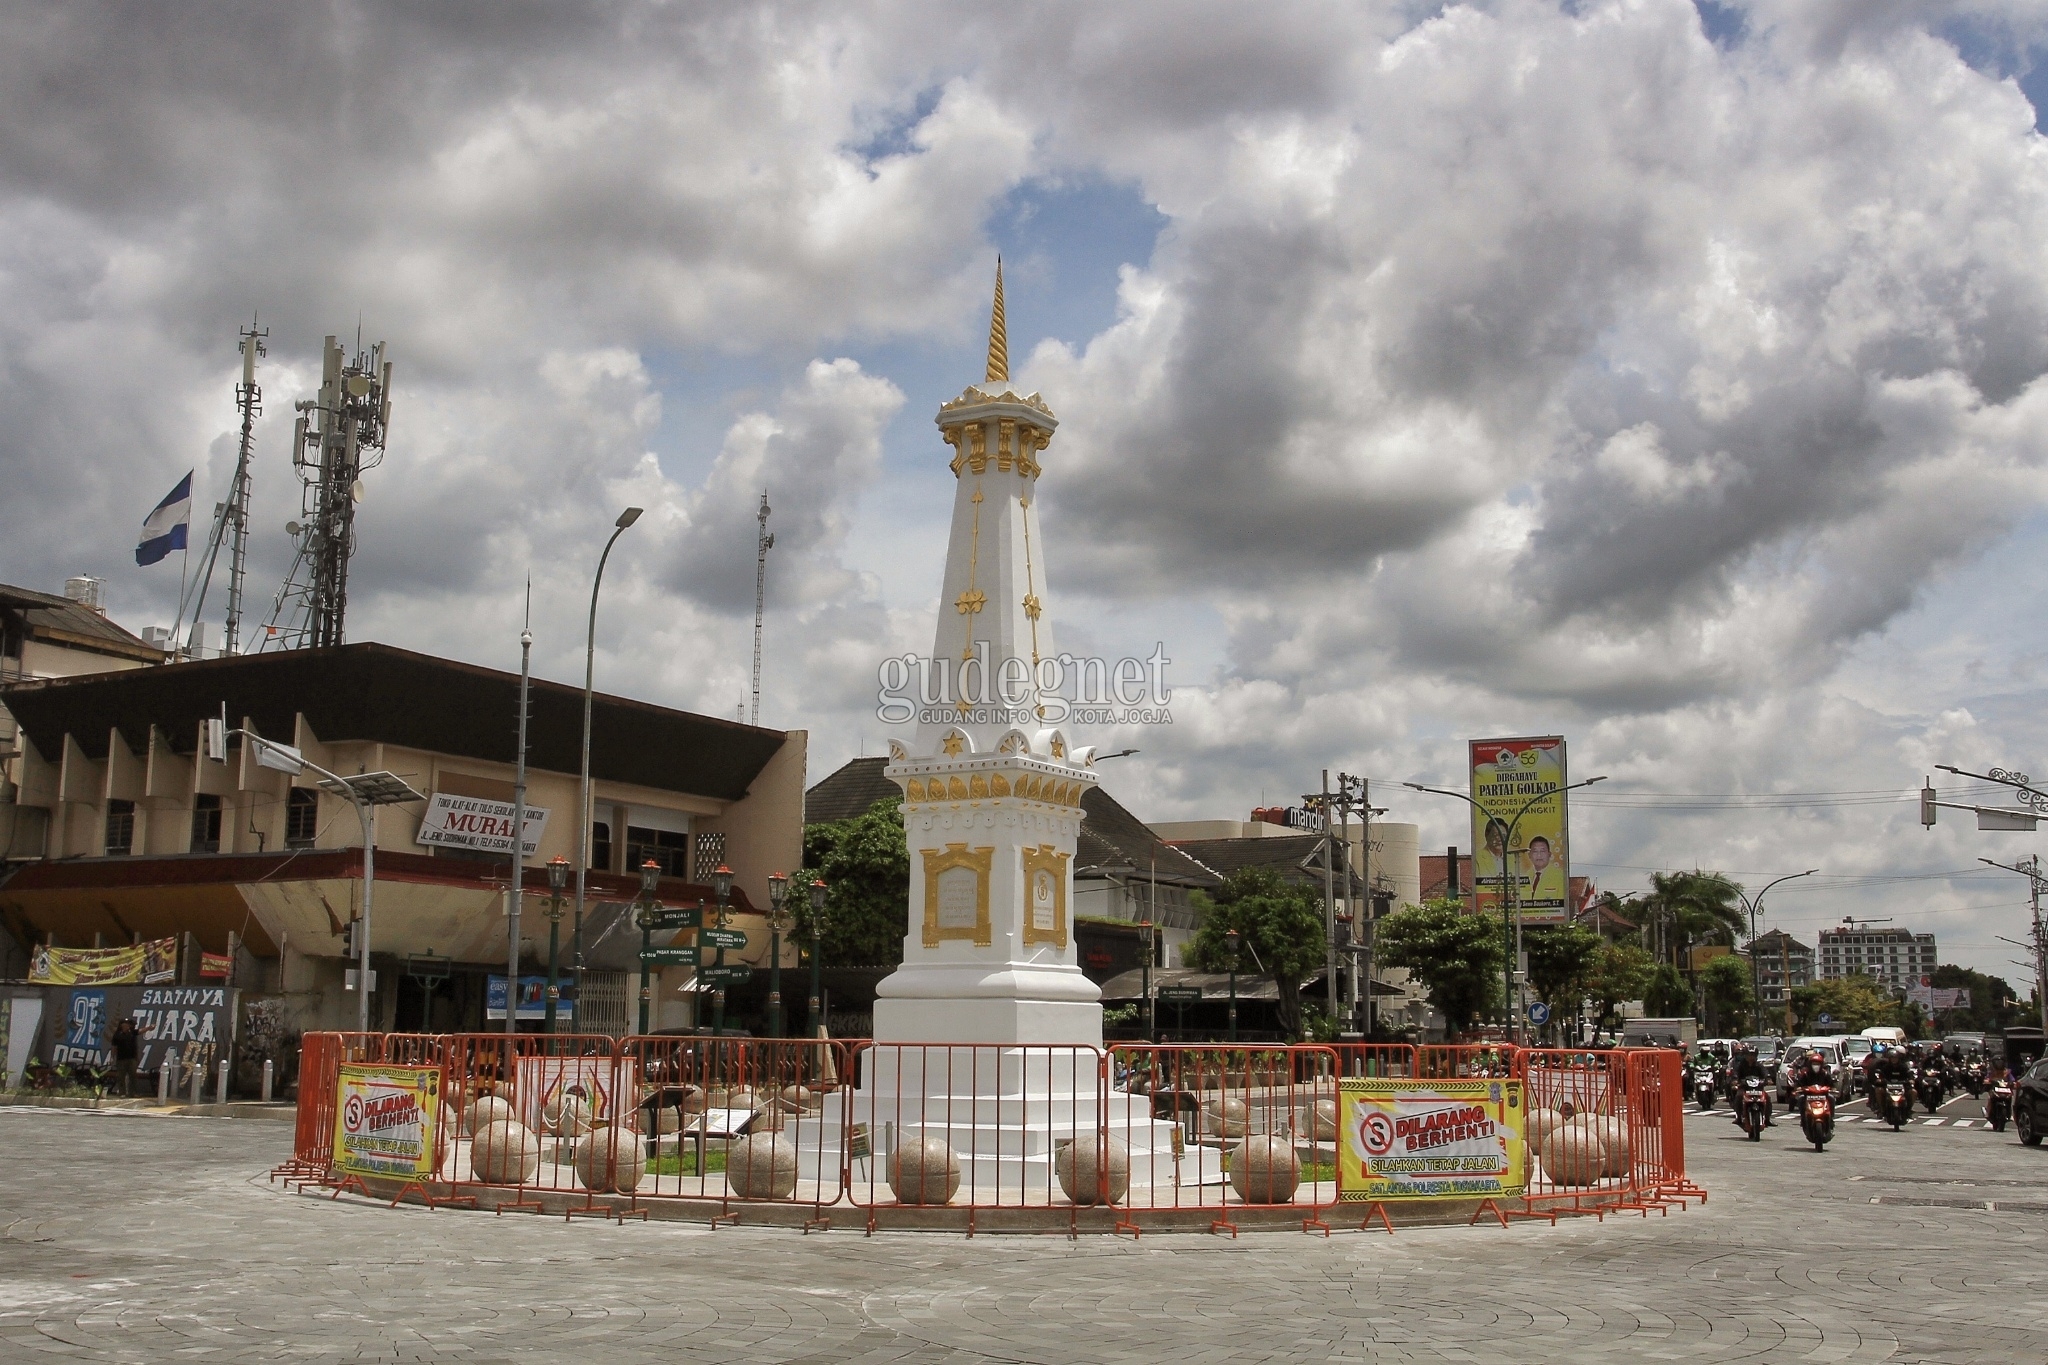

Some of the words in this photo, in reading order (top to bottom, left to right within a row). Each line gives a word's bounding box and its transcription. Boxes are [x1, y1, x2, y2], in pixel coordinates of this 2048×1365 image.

[1521, 753, 1536, 765] 56
[1496, 772, 1537, 782] DIRGAHAYU
[1479, 784, 1514, 796] PARTAI
[1517, 782, 1557, 794] GOLKAR
[437, 798, 451, 808] TOKO
[451, 800, 479, 812] ALAT-ALAT
[479, 803, 494, 813] TULIS
[493, 805, 515, 817] SEKOLAH
[525, 810, 545, 821] KANTOR
[1484, 798, 1526, 806] INDONESIA
[1290, 807, 1325, 830] mandir
[1481, 807, 1518, 816] EKONOMI
[1519, 806, 1556, 815] ANGKIT
[490, 982, 509, 993] easy
[140, 989, 225, 1006] SAATNYA
[365, 1093, 415, 1118] DILARANG
[369, 1107, 419, 1130] BERHENTI
[1396, 1106, 1485, 1138] DILARANG
[1370, 1122, 1385, 1146] S
[1406, 1121, 1495, 1150] BERHENTI
[345, 1136, 378, 1150] SILAHKAN
[378, 1139, 398, 1152] TETAP
[398, 1141, 418, 1154] JALAN
[1371, 1159, 1426, 1172] SILAHKAN
[1426, 1158, 1461, 1171] TETAP
[1462, 1158, 1496, 1170] JALAN
[1369, 1182, 1412, 1194] SATLANTAS
[1413, 1181, 1452, 1194] POLRESTA
[1452, 1180, 1502, 1192] YOGYAKARTA
